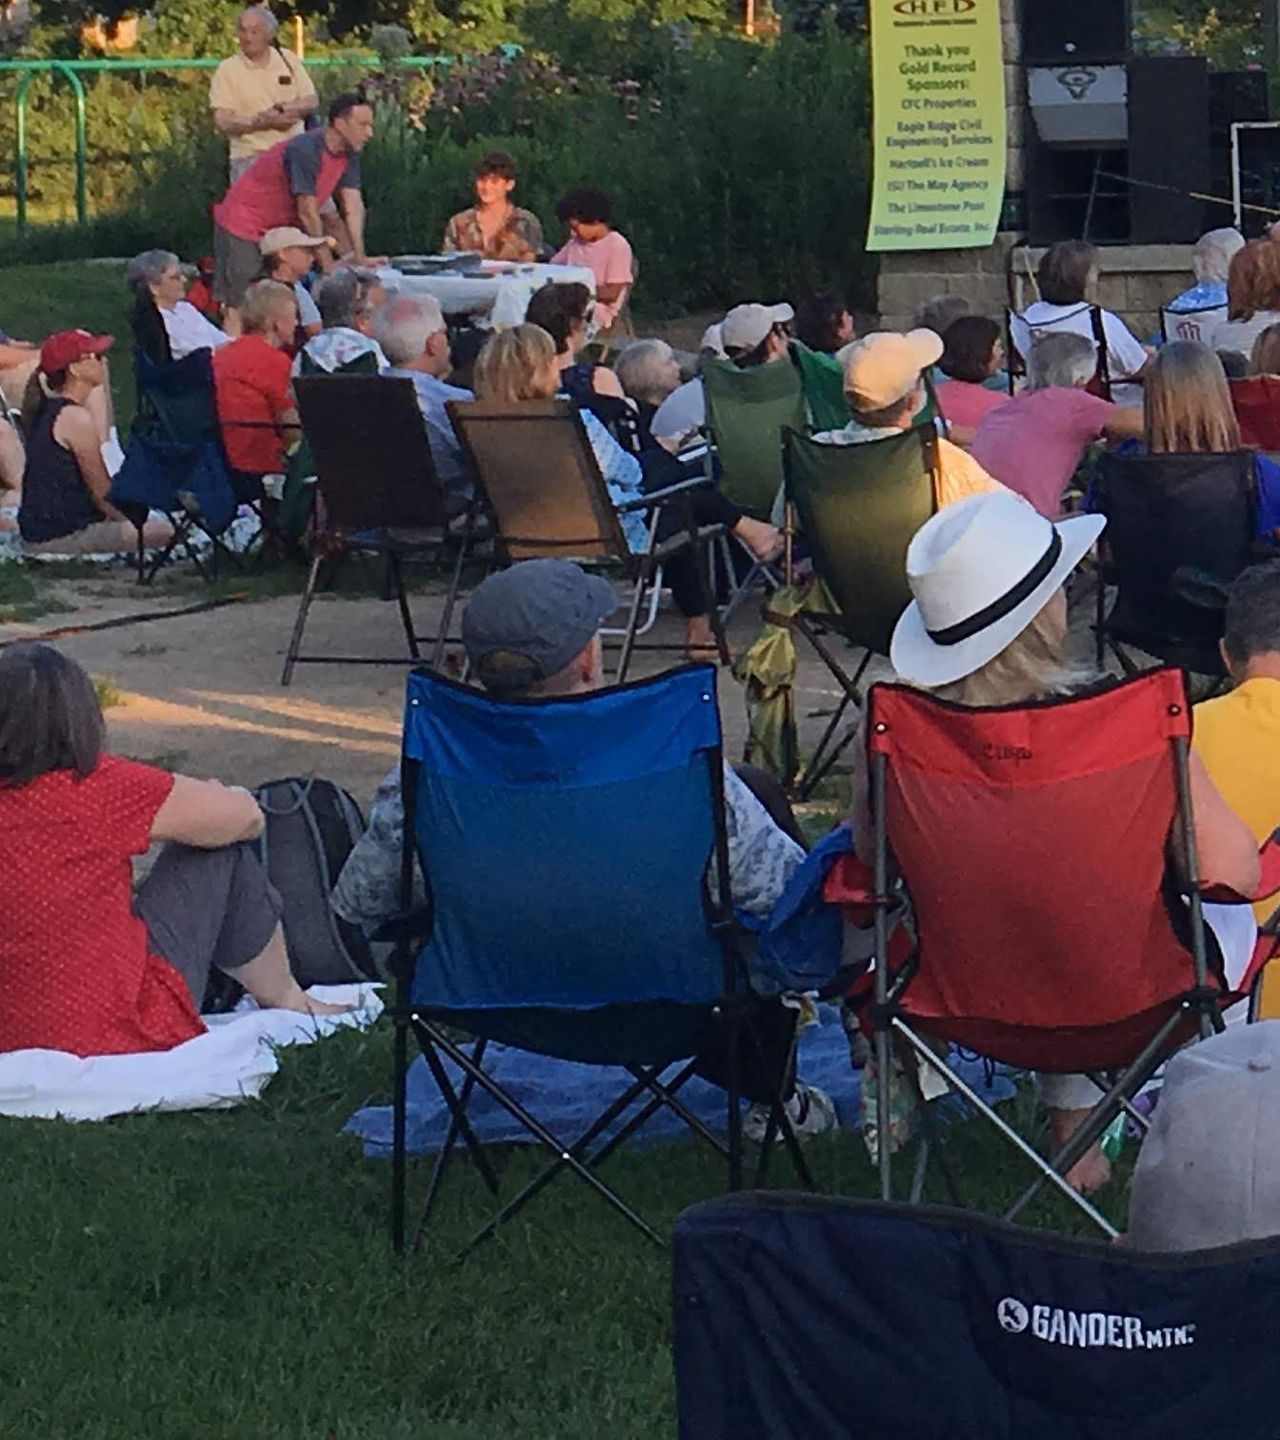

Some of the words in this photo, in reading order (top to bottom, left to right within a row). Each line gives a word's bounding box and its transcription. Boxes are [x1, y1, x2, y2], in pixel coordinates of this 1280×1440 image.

[904, 44, 943, 57] Thank
[946, 46, 970, 59] you
[899, 62, 929, 75] Gold
[932, 60, 976, 73] Record
[1032, 1304, 1145, 1349] GANDER
